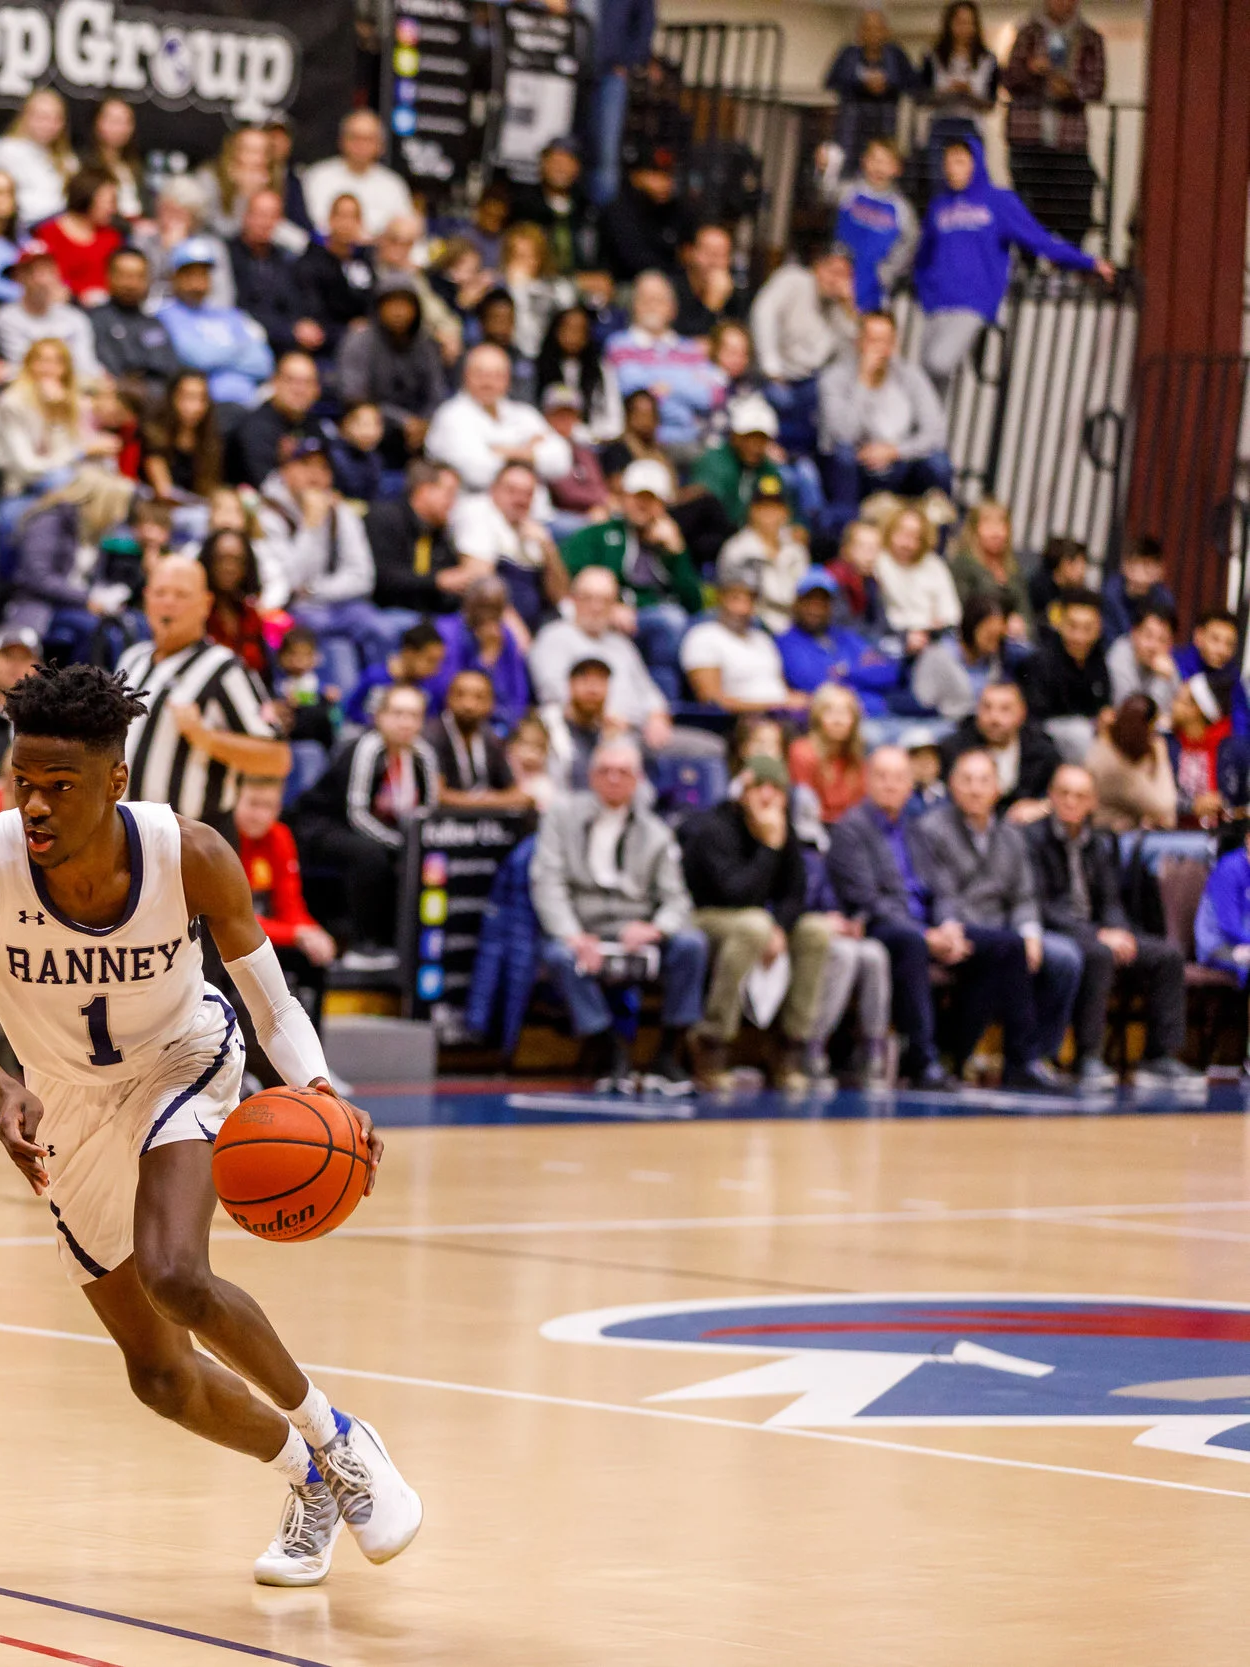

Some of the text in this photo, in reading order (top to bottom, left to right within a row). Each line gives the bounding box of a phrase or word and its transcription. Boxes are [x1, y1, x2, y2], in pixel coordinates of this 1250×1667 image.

[5, 936, 183, 985] RANNEY
[78, 992, 126, 1067] 1
[232, 1203, 316, 1234] Baden
